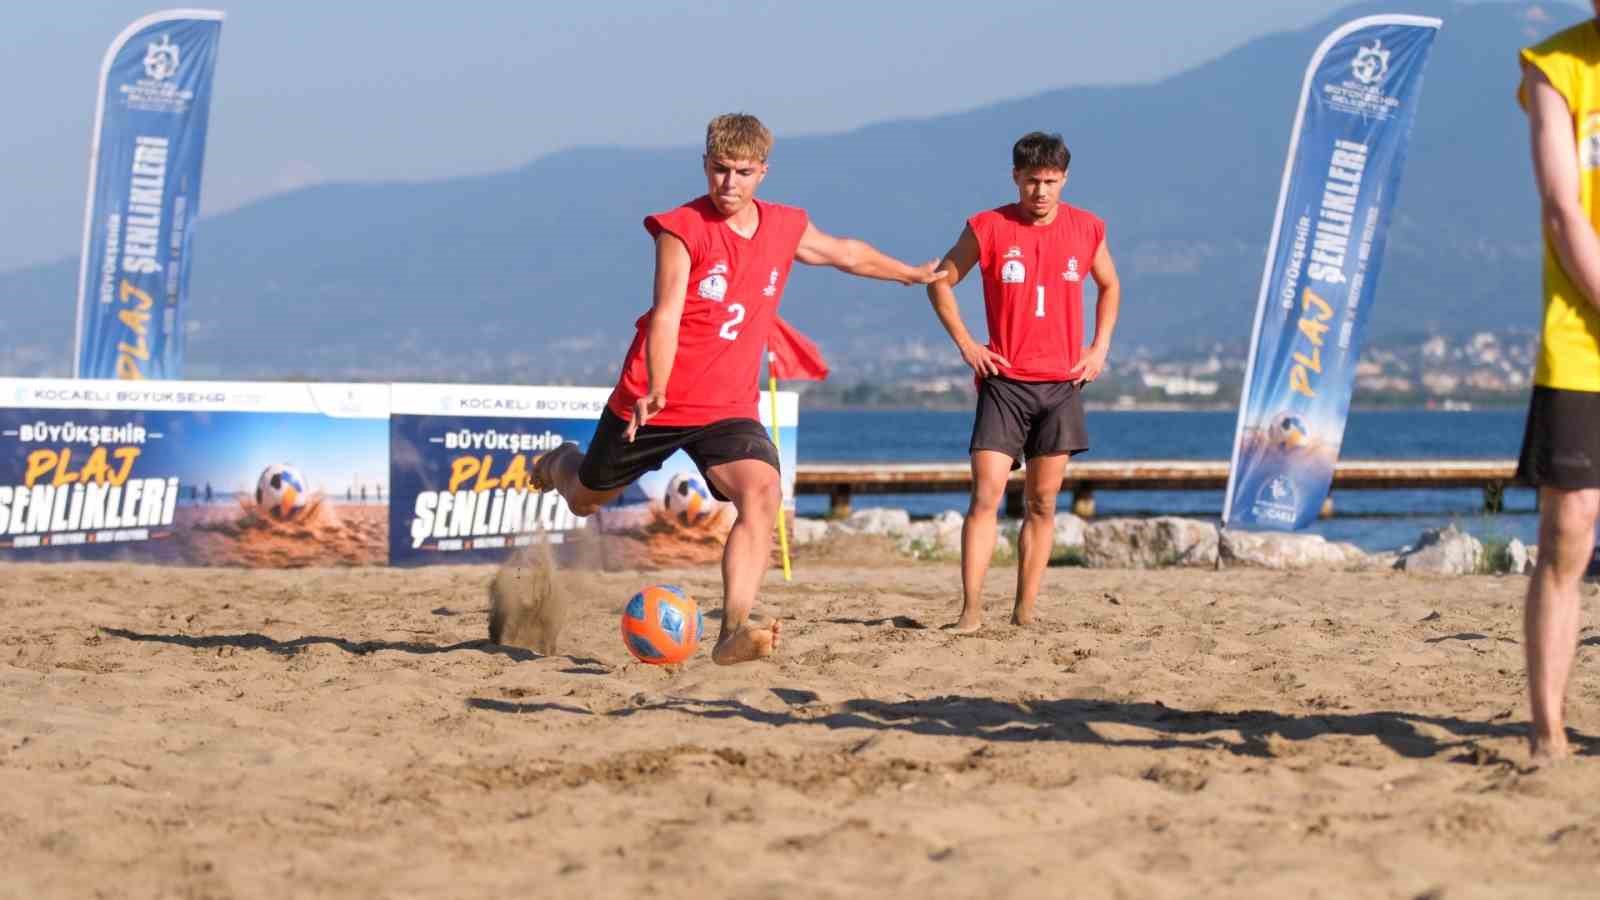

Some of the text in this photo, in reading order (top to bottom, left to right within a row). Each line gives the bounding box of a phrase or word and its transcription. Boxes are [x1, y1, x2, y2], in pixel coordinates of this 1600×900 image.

[1307, 139, 1369, 283] ŞENLİKLERİ
[1034, 285, 1046, 318] 1
[719, 303, 746, 341] 2
[1289, 287, 1335, 398] PLAJ
[19, 421, 147, 447] BÜYÜKŞEHİR
[25, 446, 142, 488] PLAJ
